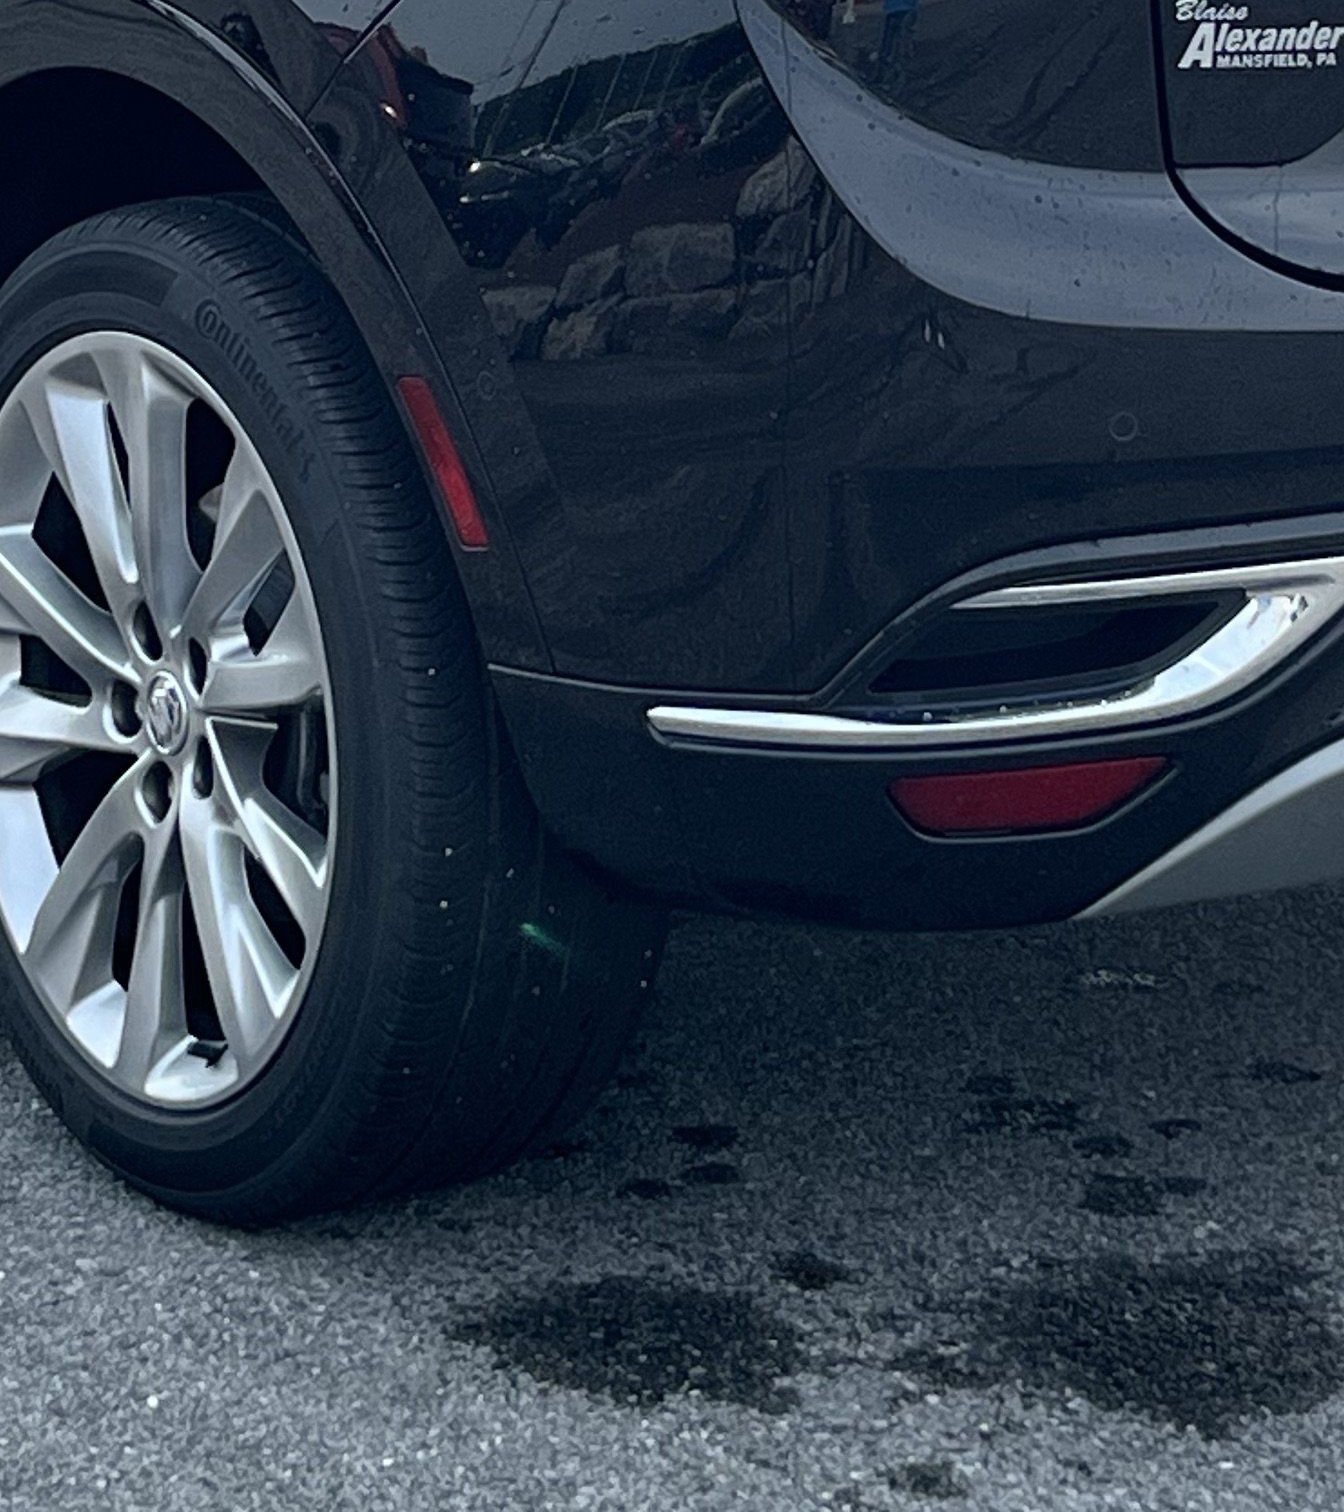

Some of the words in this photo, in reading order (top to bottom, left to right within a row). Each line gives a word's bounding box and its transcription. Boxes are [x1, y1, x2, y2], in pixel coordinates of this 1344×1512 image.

[1215, 54, 1313, 69] MANSFIELD,
[1316, 52, 1337, 66] PA
[194, 298, 306, 452] Continental
